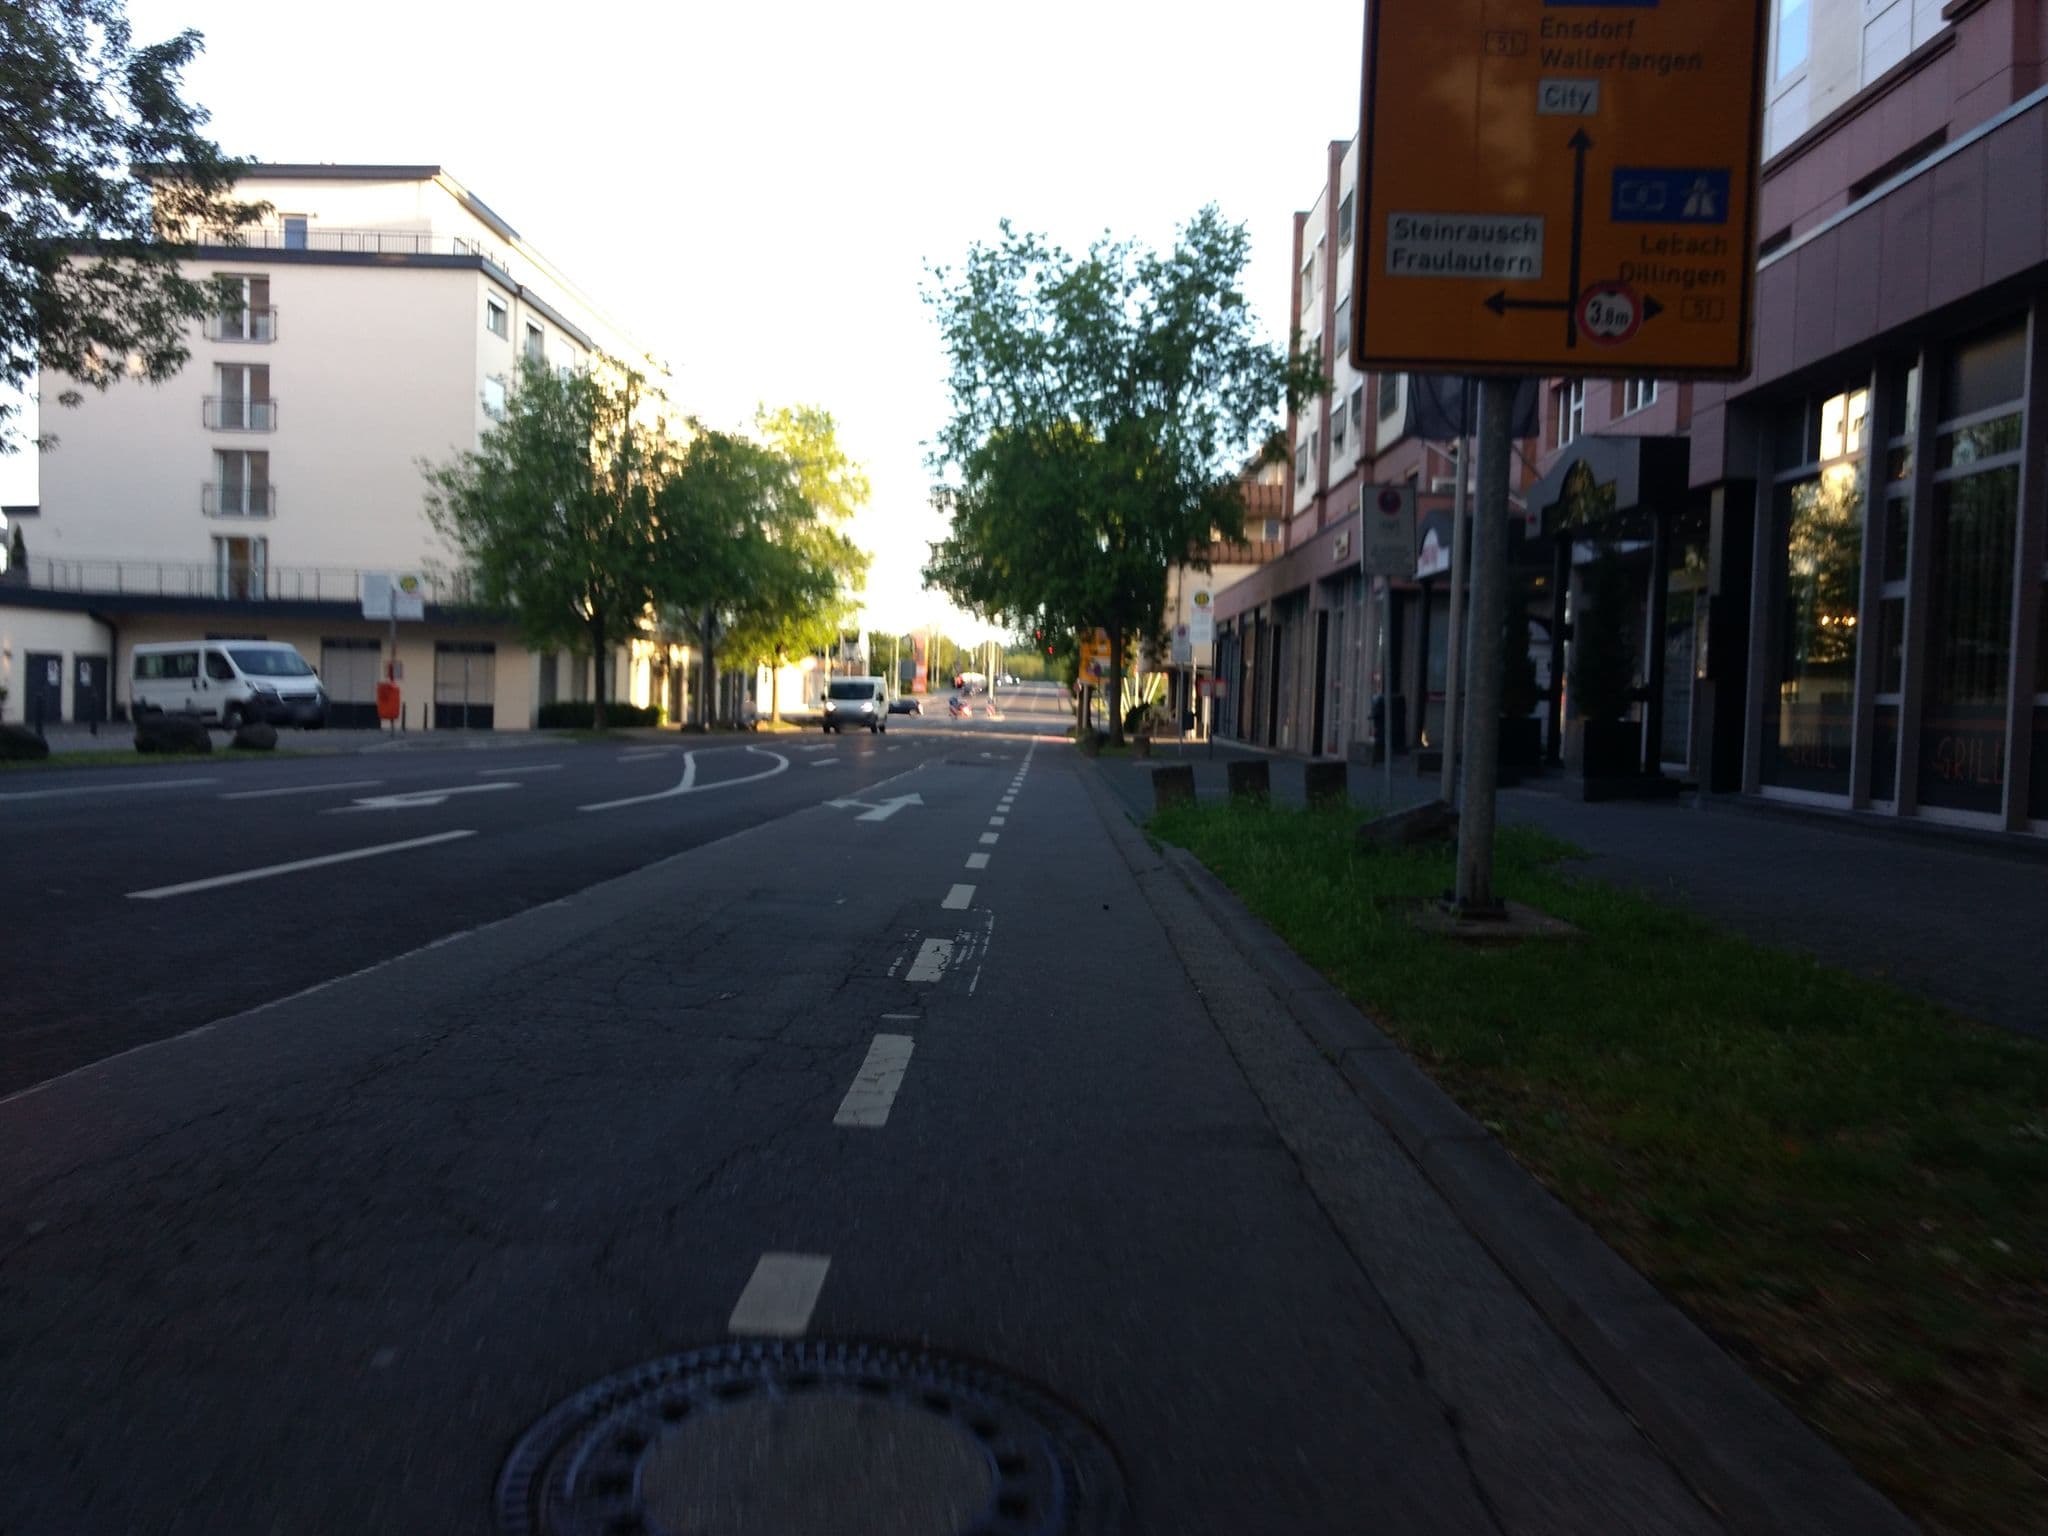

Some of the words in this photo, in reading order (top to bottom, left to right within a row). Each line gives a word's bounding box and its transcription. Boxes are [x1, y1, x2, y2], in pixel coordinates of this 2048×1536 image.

[1540, 17, 1636, 39] Ensdorf
[1540, 47, 1703, 75] Wallerfangen
[1544, 85, 1593, 113] City
[1394, 217, 1538, 243] Steinrausch
[1640, 232, 1729, 256] Lebach
[1392, 247, 1533, 273] Fraulautern
[1619, 260, 1727, 288] Dillingen
